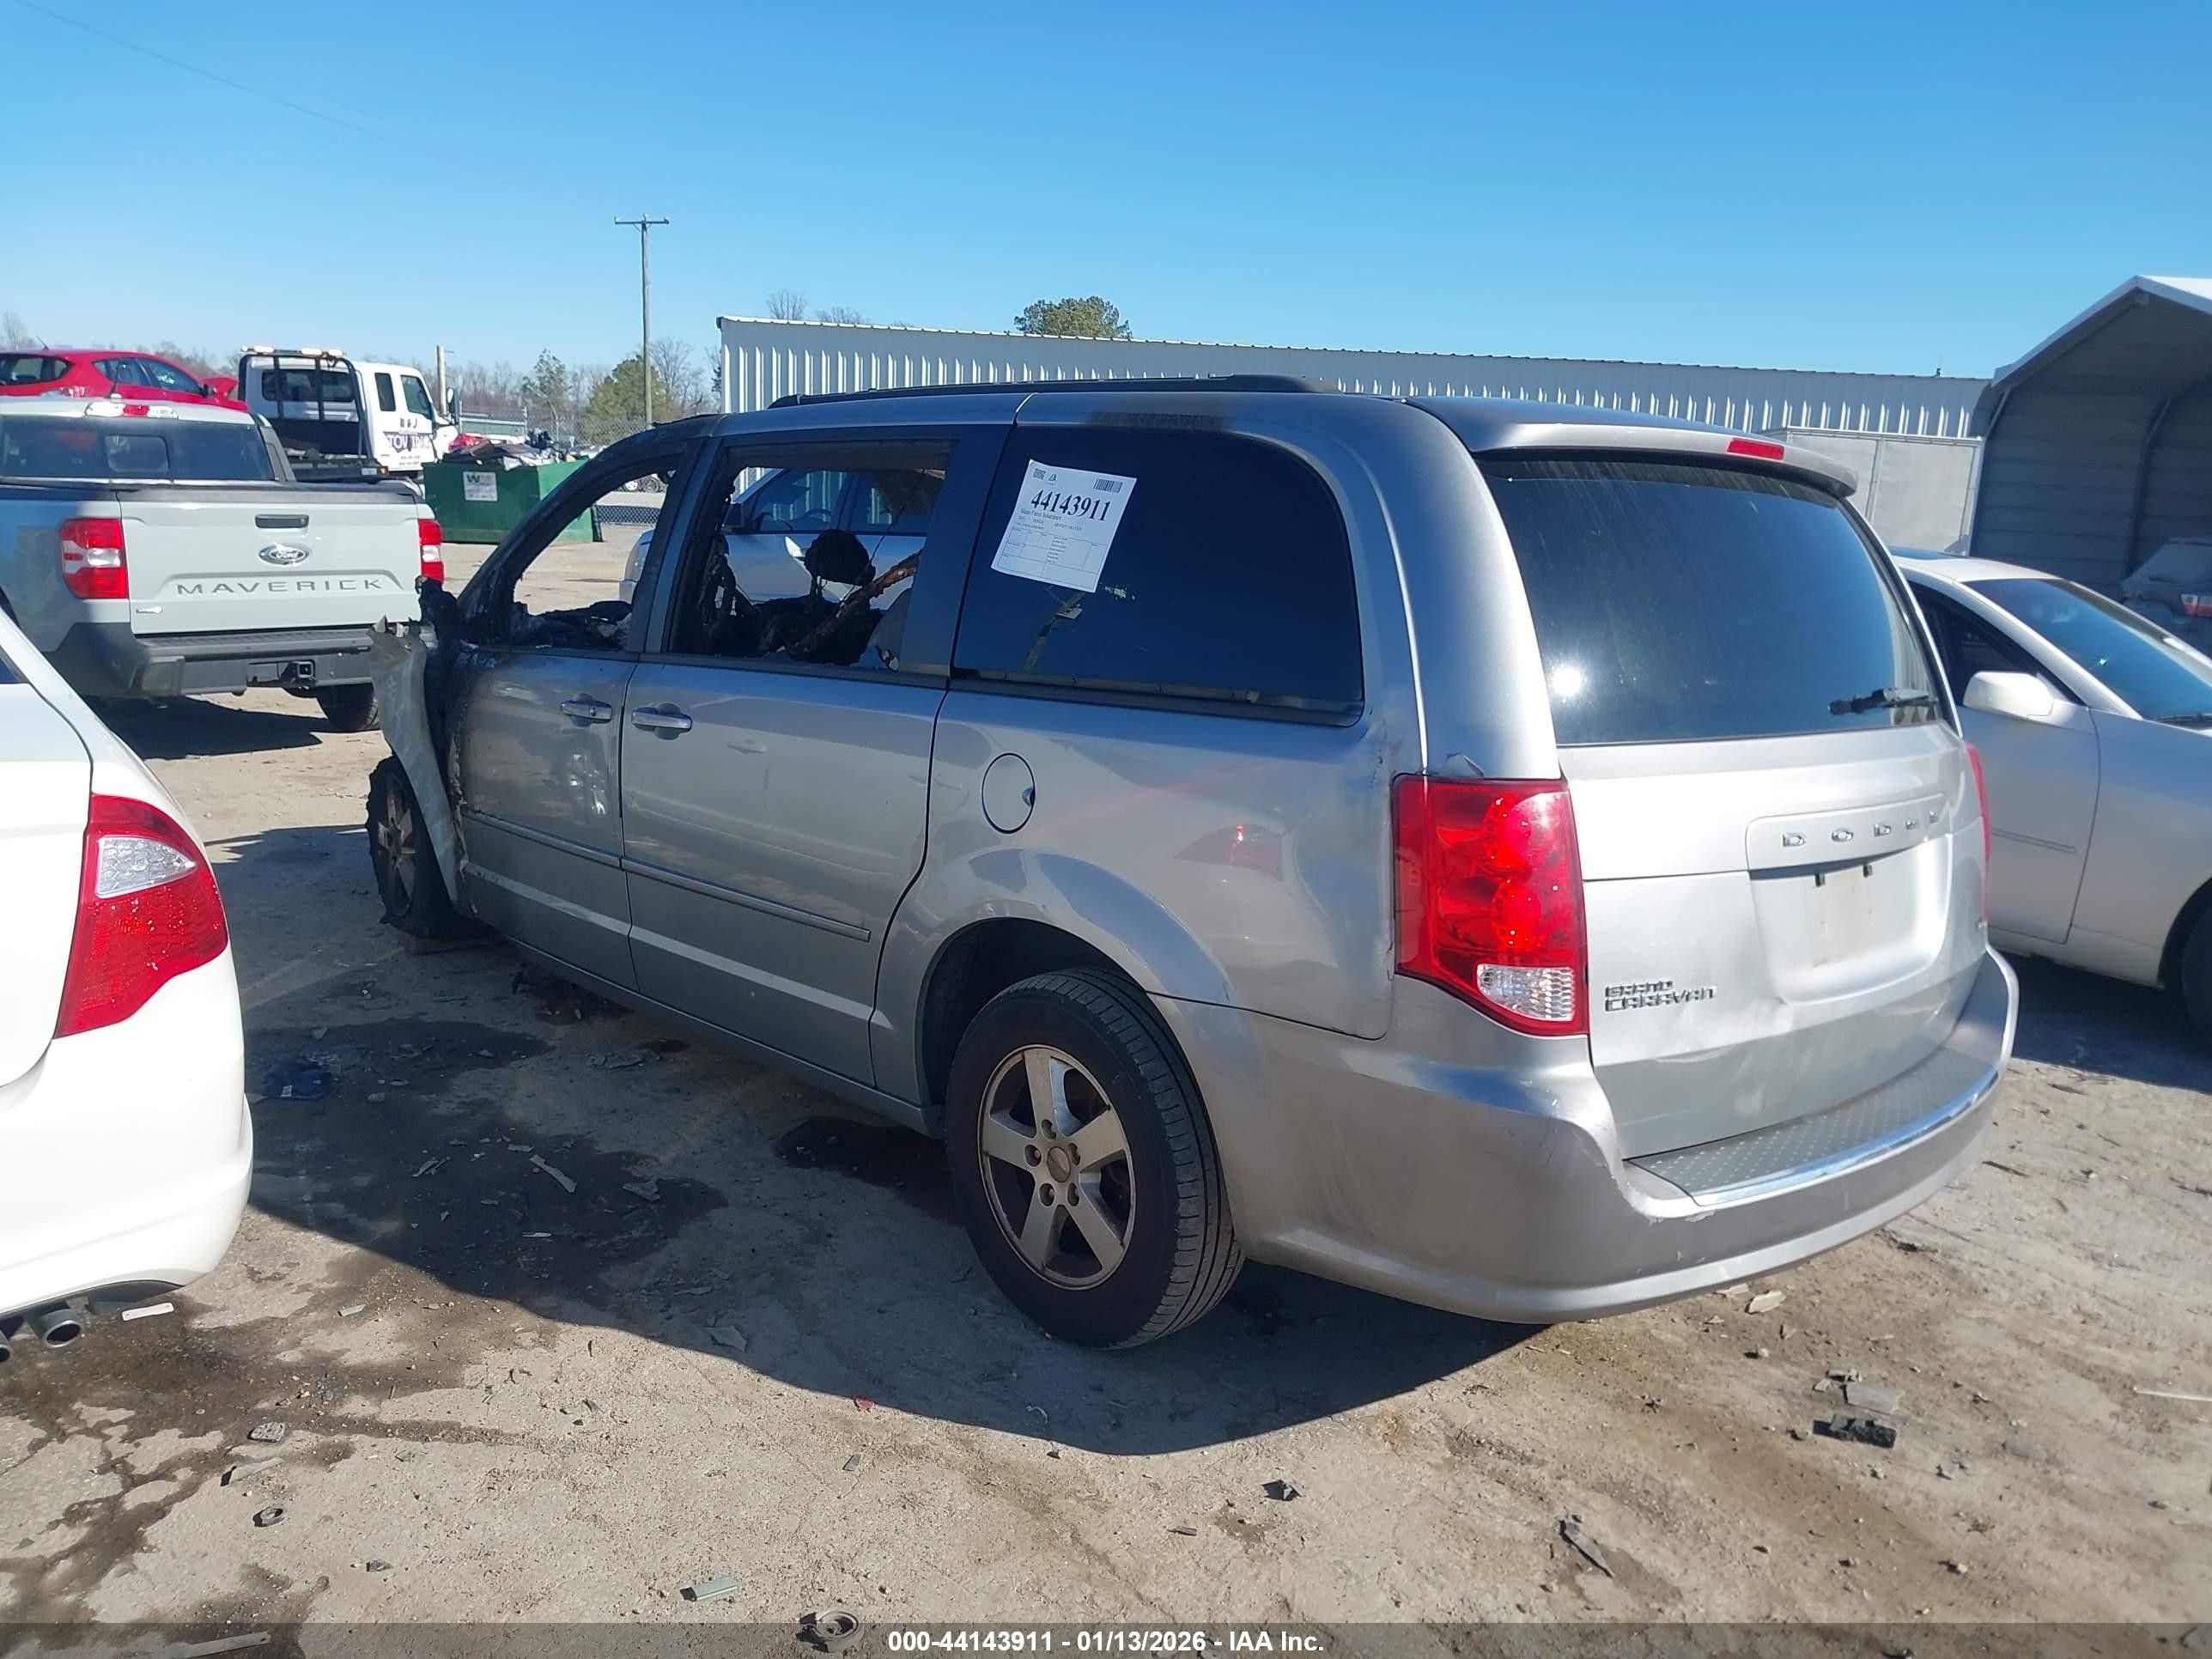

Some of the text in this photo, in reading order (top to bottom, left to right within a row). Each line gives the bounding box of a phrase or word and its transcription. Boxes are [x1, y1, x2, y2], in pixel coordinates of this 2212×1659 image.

[1030, 489, 1112, 521] 44143911
[176, 579, 382, 594] MAVERICK
[1782, 810, 1939, 848] DODGE
[1604, 980, 1674, 998] GRAND
[1604, 987, 1714, 1012] CARAVAN
